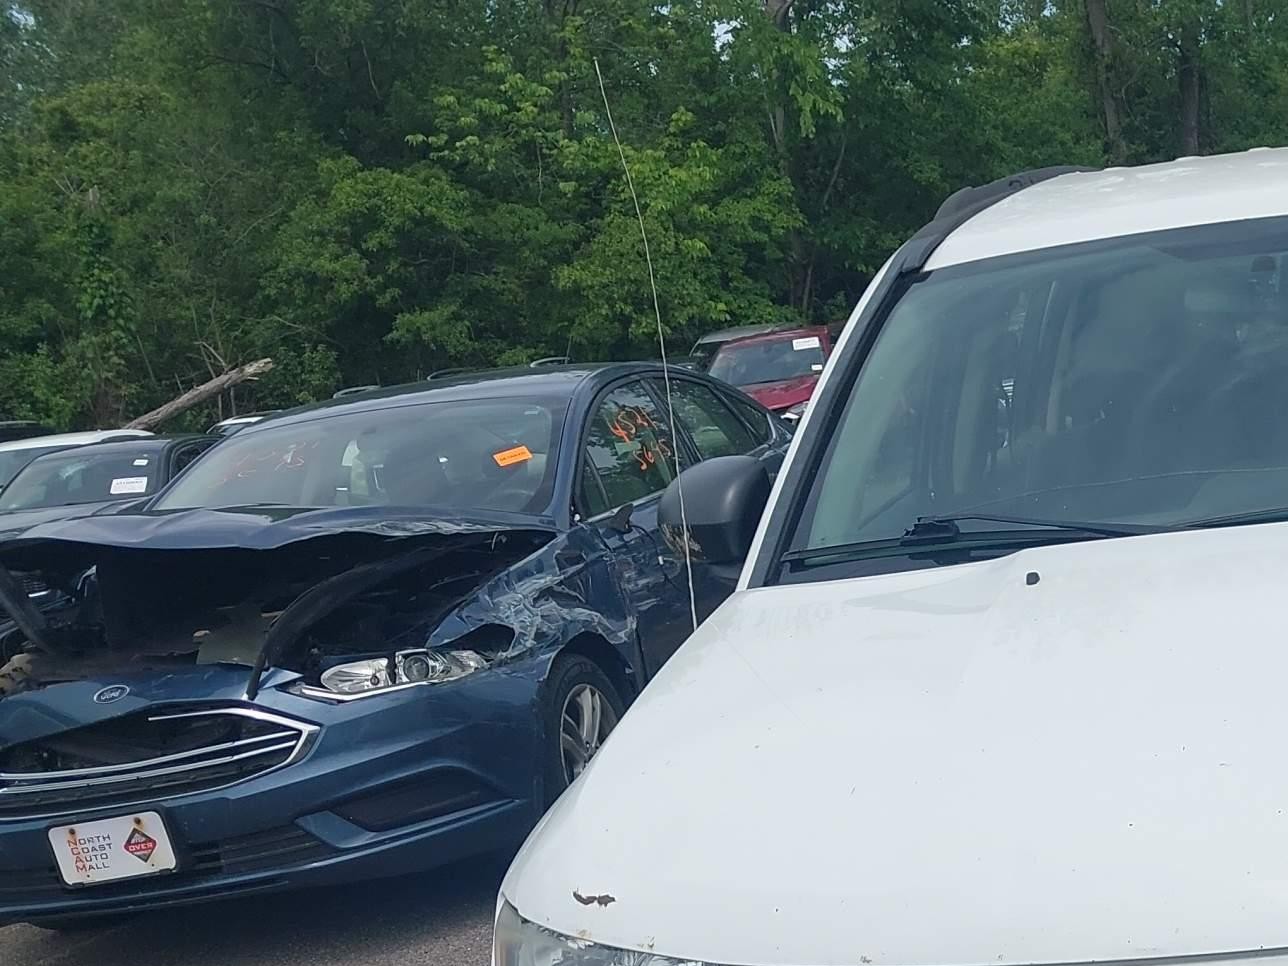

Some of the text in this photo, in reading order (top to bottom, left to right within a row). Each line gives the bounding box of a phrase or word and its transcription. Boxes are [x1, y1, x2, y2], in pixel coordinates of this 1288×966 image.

[67, 834, 111, 848] NORTH
[128, 842, 154, 852] OVER
[71, 843, 113, 856] COAST
[75, 853, 109, 865] AUTO
[75, 862, 110, 873] MALL
